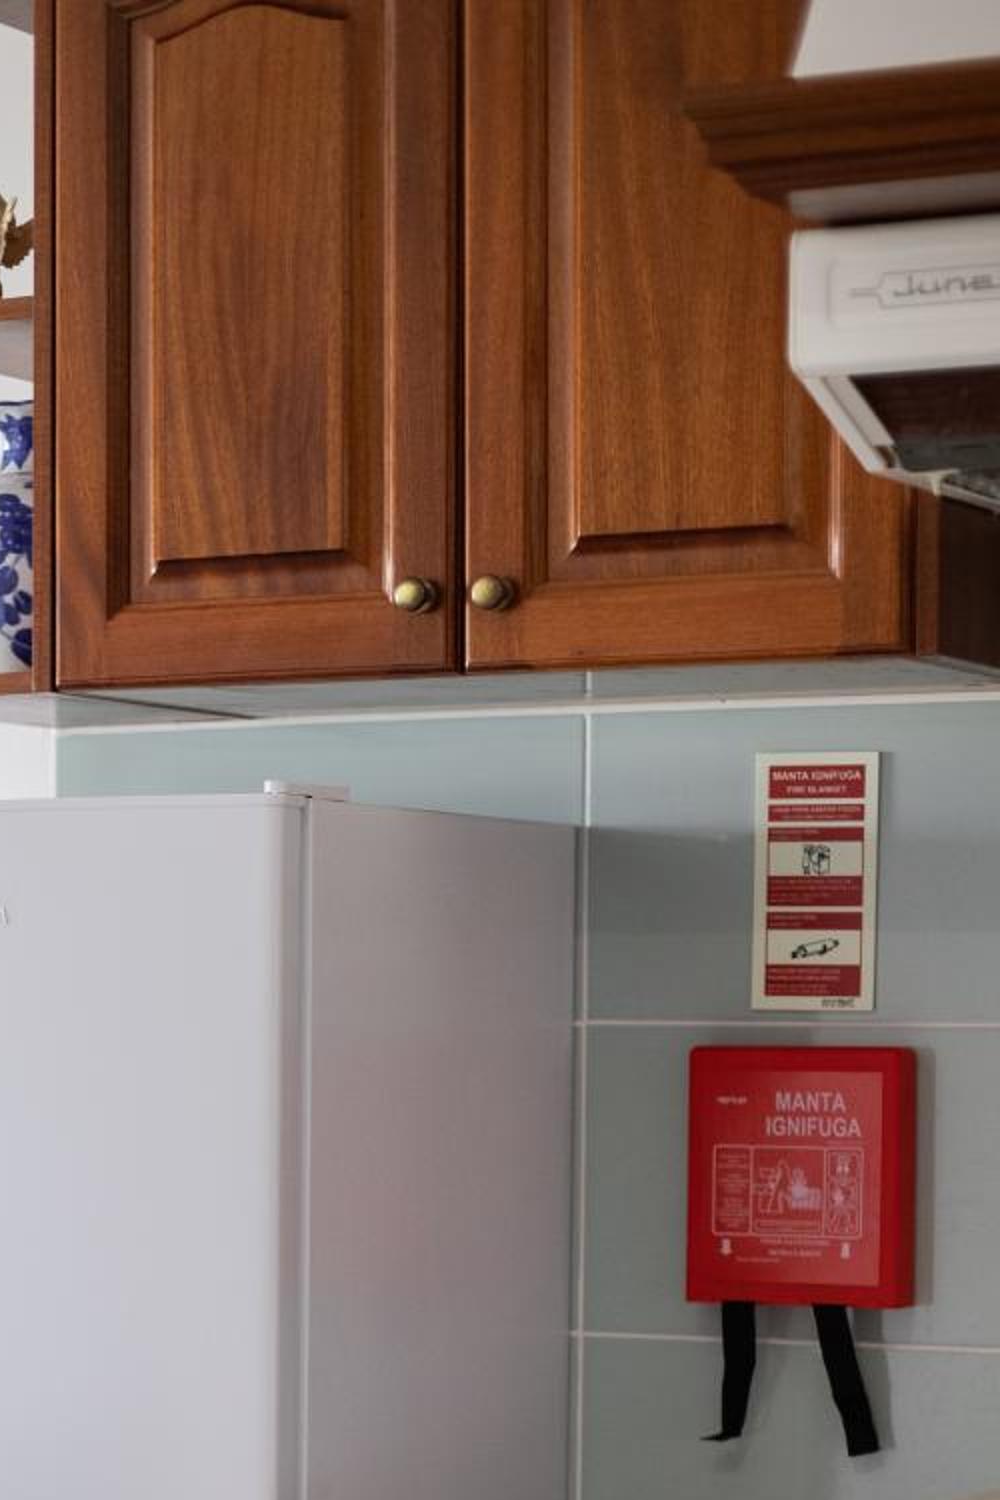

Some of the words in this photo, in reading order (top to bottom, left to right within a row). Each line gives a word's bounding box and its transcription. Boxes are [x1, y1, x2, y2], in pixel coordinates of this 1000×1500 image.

[772, 770, 809, 781] MANTA
[775, 1091, 846, 1113] MANTA
[766, 1115, 862, 1137] IGNIFUGA
